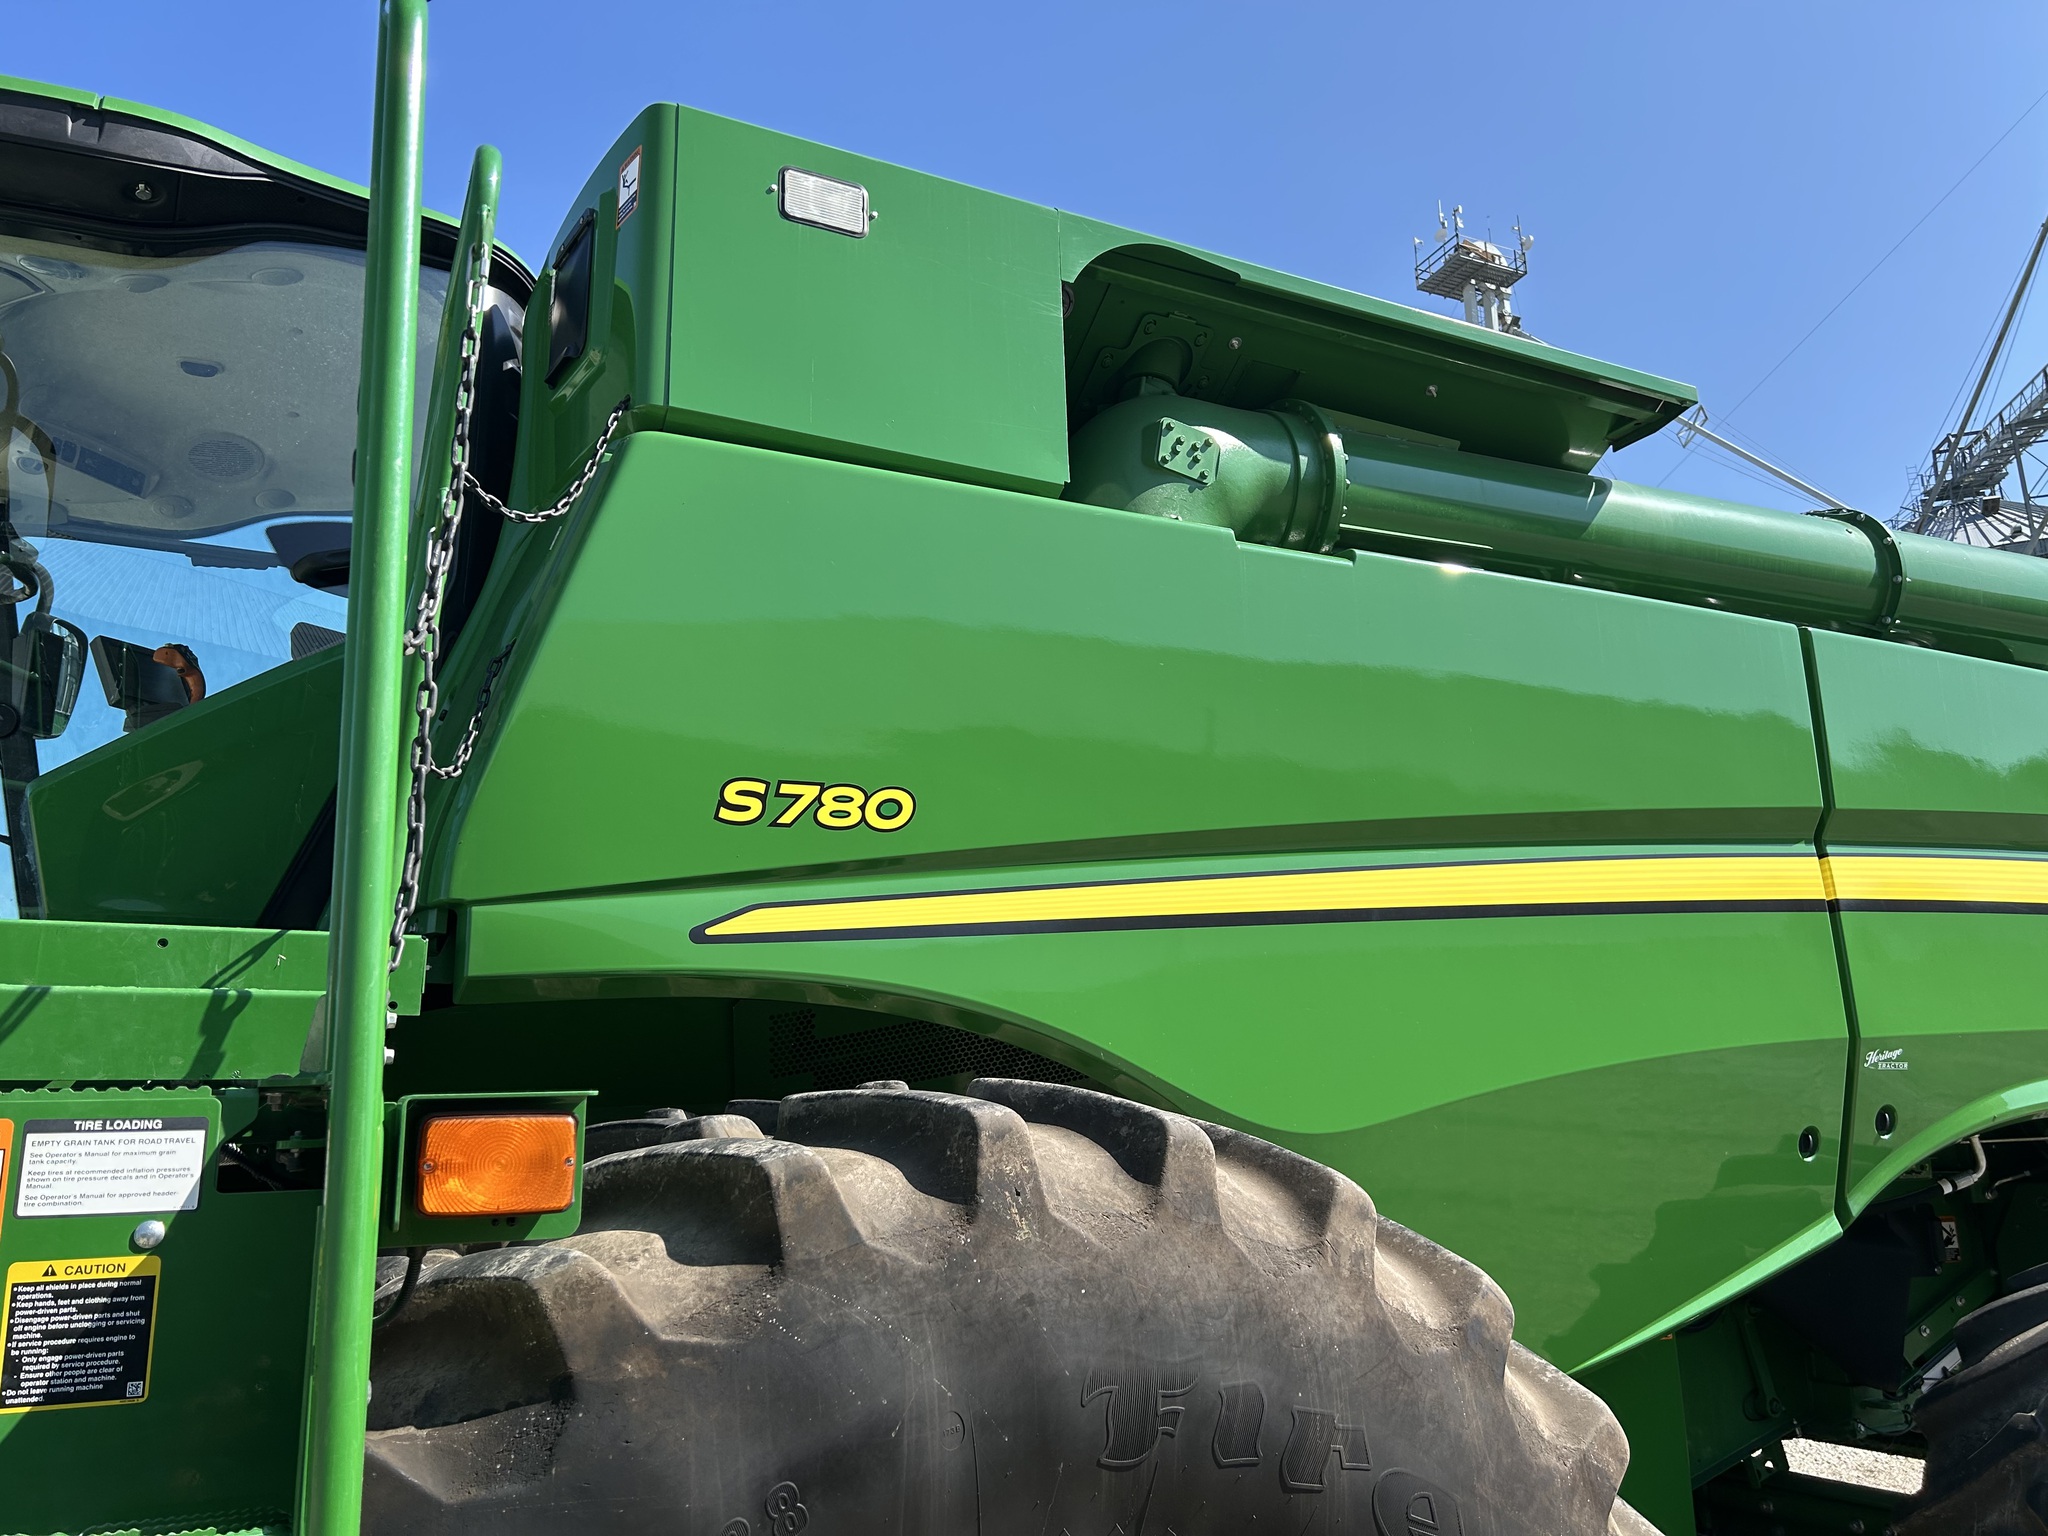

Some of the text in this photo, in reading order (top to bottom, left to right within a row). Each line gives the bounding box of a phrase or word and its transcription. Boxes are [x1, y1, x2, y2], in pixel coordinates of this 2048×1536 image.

[1864, 1048, 1903, 1067] Heritage
[1878, 1062, 1908, 1070] TRACTOR
[74, 1119, 162, 1130] TIRE LOADING
[65, 1263, 126, 1275] CAUTION
[78, 1282, 96, 1290] place
[15, 1307, 78, 1317] power-driven parts.
[50, 1314, 92, 1323] power-driven
[24, 1324, 46, 1332] engine
[43, 1338, 76, 1346] procedure
[78, 1336, 104, 1344] requires
[106, 1334, 127, 1342] engine
[64, 1352, 106, 1360] power-driven
[22, 1363, 50, 1371] required
[86, 1359, 120, 1367] procedure.
[21, 1380, 49, 1388] operator
[49, 1385, 74, 1393] running
[5, 1396, 44, 1404] unattended.
